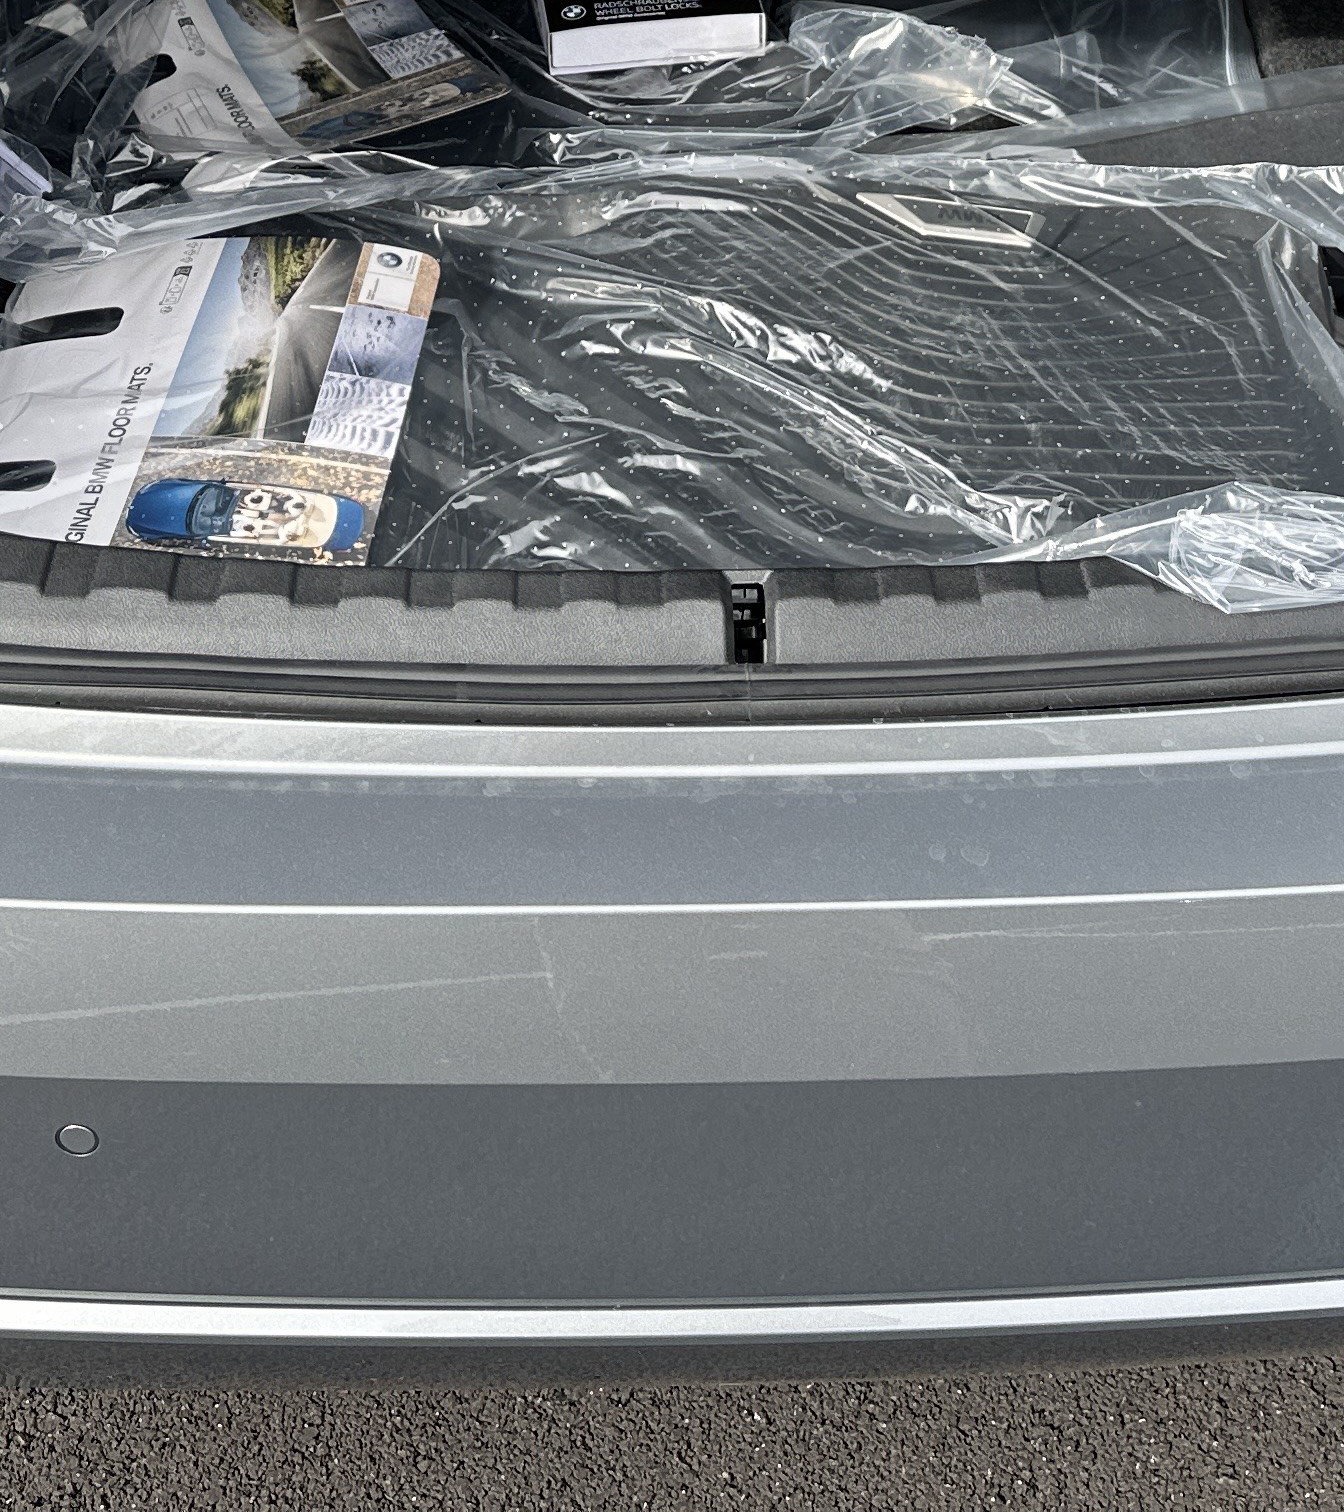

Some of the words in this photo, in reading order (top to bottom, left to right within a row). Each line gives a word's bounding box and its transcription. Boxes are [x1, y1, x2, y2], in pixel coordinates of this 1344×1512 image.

[594, 6, 634, 16] WHEEL
[636, 4, 662, 14] BOLT
[84, 456, 115, 495] BMW
[100, 405, 136, 455] FLOOR
[120, 362, 154, 405] MATS.
